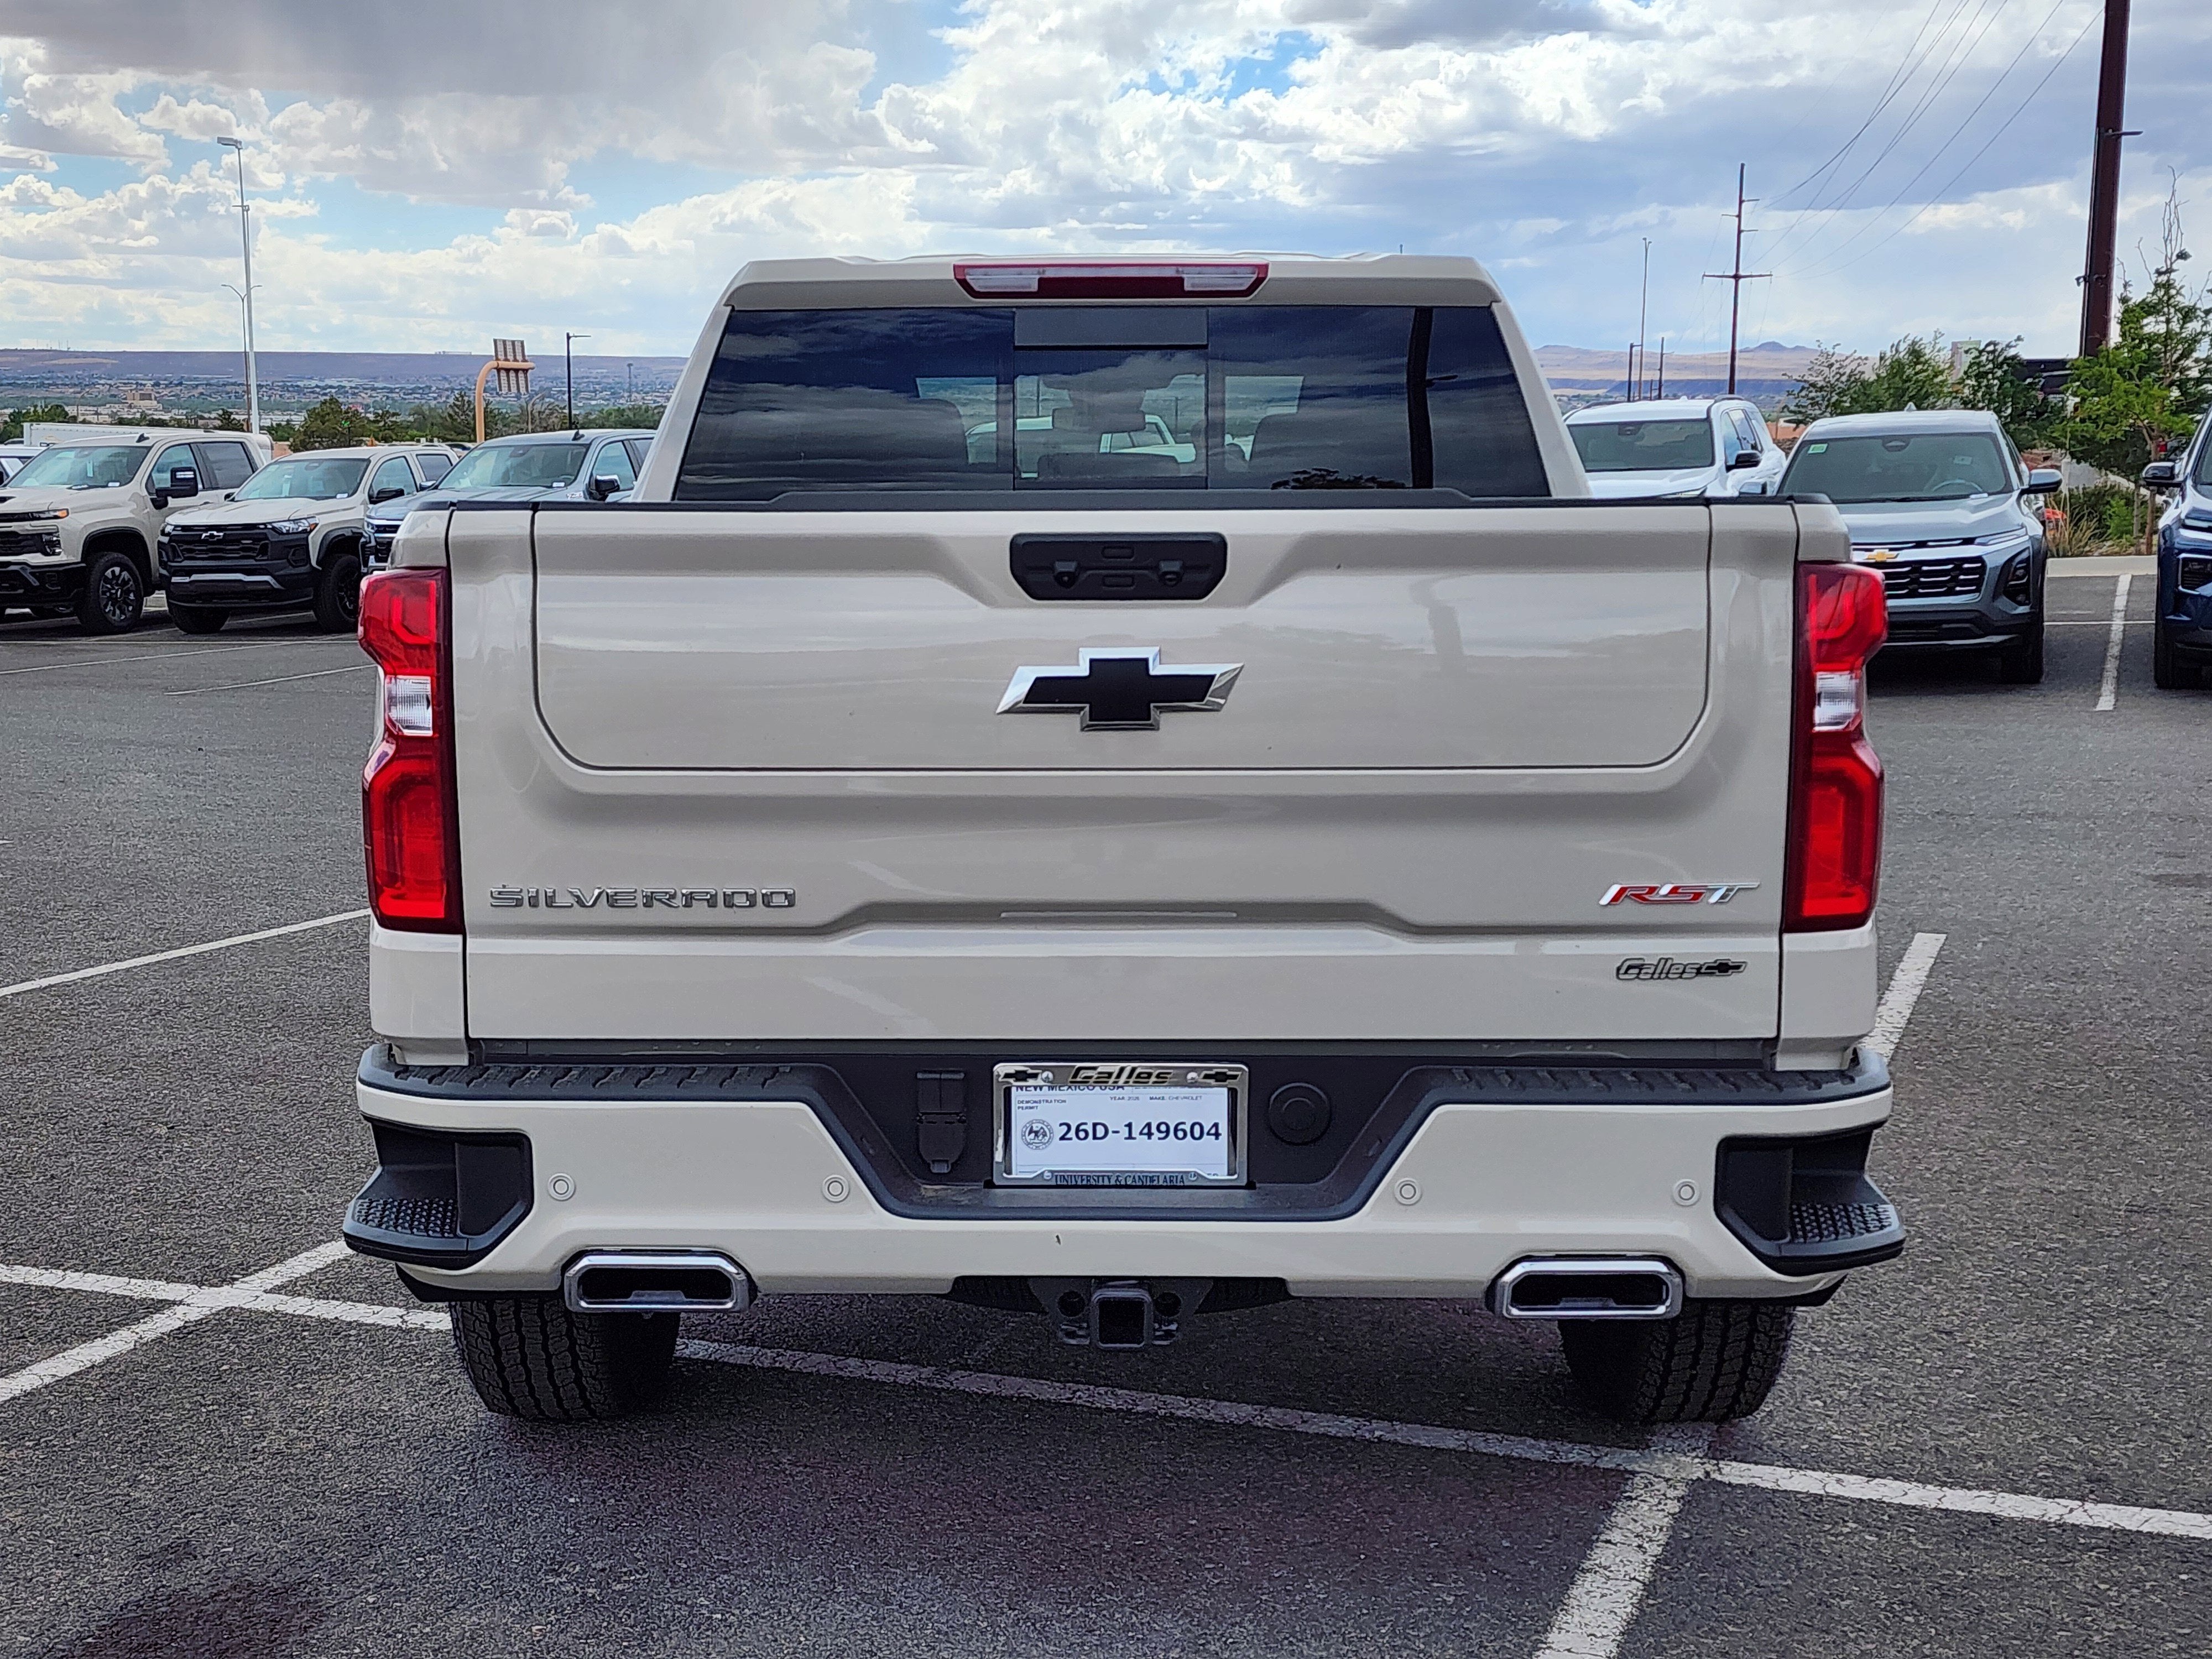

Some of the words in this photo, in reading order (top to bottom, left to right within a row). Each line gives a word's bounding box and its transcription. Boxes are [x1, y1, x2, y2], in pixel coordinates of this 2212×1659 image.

[490, 886, 796, 908] SILVERADO
[1599, 882, 1760, 905] RST
[1616, 957, 1701, 980] Galles
[1068, 1065, 1174, 1084] Galles
[1058, 1121, 1222, 1141] 26D-149604
[1055, 1173, 1112, 1186] UNIVERSITY
